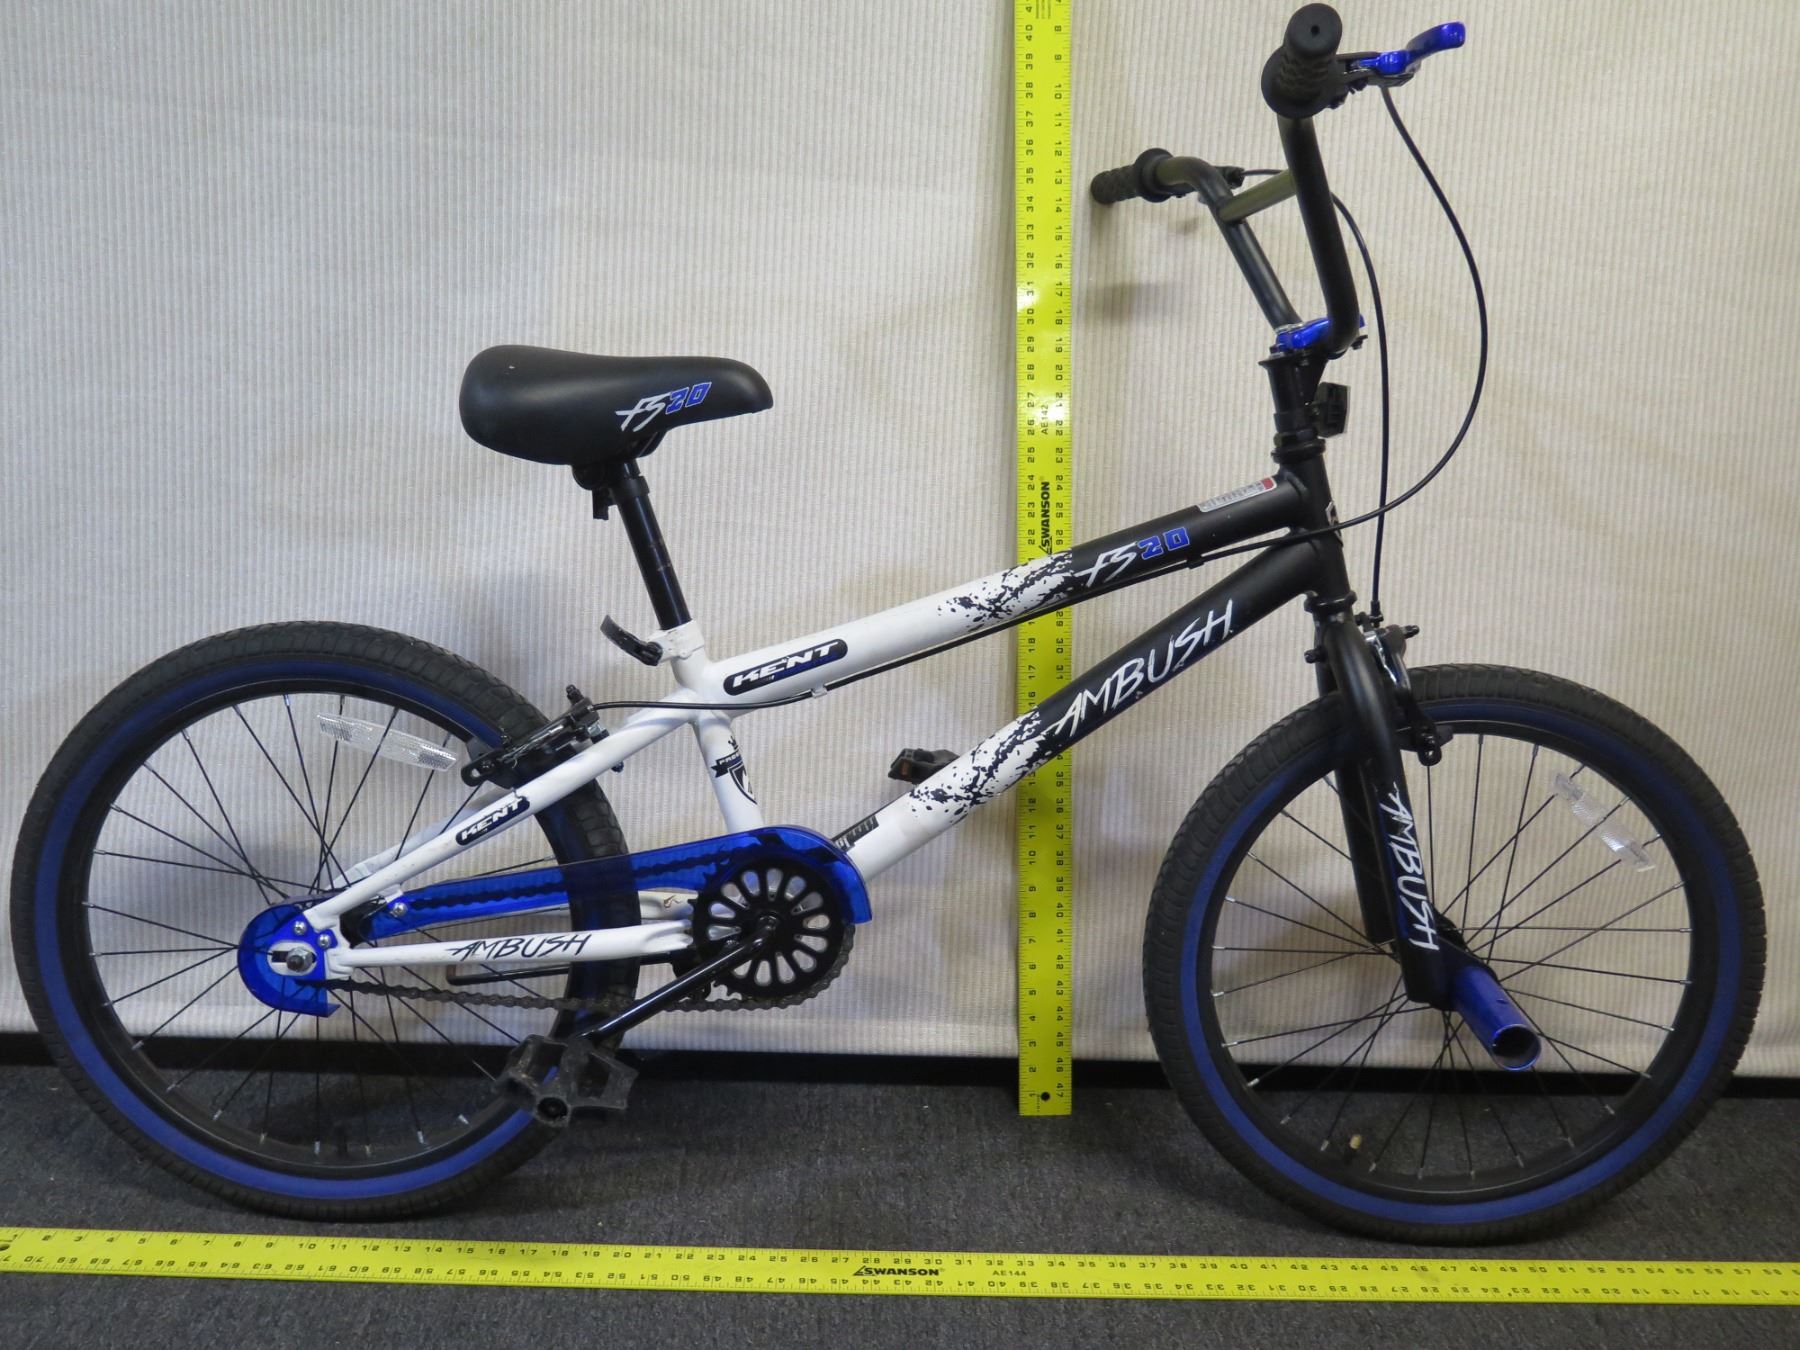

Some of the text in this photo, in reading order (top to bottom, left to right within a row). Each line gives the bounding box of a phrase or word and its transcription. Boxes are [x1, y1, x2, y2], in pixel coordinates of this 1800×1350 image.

[1025, 25, 1033, 41] 40
[1026, 53, 1033, 70] 39
[1026, 82, 1033, 98] 38
[1026, 110, 1033, 127] 37
[1026, 139, 1033, 156] 36
[1026, 167, 1034, 184] 35
[1026, 196, 1034, 212] 34
[1026, 224, 1034, 240] 33
[1026, 252, 1034, 268] 32
[1027, 280, 1034, 297] 31
[1027, 308, 1034, 324] 30
[1027, 336, 1034, 352] 29
[1027, 364, 1034, 380] 28
[615, 382, 712, 432] FS20
[1027, 391, 1034, 408] 27
[1027, 419, 1034, 436] 26
[1027, 446, 1035, 463] 25
[1027, 474, 1035, 490] 24
[1027, 501, 1035, 518] 23
[1040, 482, 1050, 547] SWANSON
[1028, 529, 1035, 545] 22
[1074, 527, 1190, 587] FS20
[1028, 637, 1035, 654] 18
[733, 641, 838, 688] KENT
[1028, 664, 1035, 680] 17
[1041, 599, 1233, 738] AMBUSH
[1028, 691, 1035, 707] 16
[1028, 797, 1036, 814] 12
[461, 798, 523, 840] KENT
[1028, 823, 1036, 840] 11
[1028, 850, 1036, 866] 10
[1380, 781, 1440, 950] AMBUSH
[445, 934, 591, 962] AMBUSH
[864, 1268, 939, 1276] SWANSON
